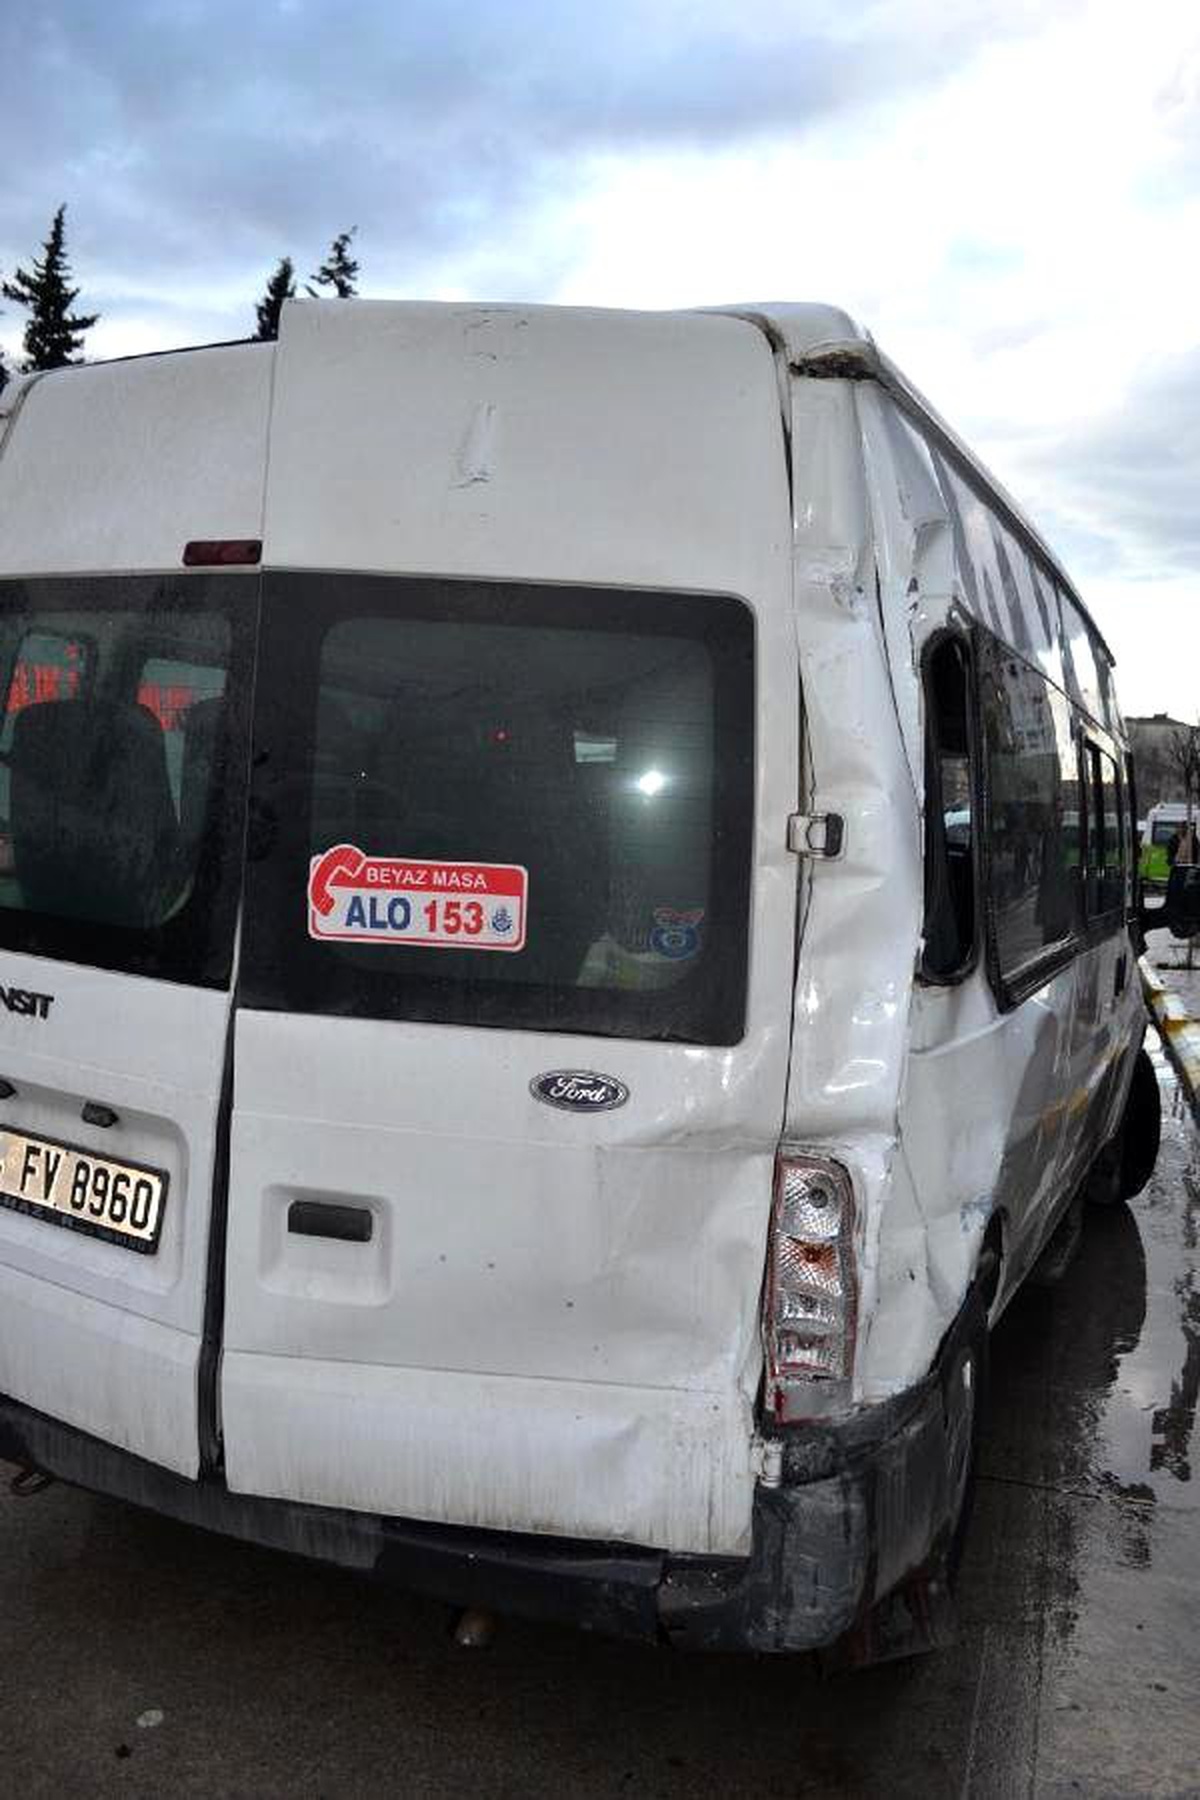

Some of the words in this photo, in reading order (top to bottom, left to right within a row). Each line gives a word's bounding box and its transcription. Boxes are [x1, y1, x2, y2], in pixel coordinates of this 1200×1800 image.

[366, 867, 427, 886] BEYAZ
[432, 872, 489, 889] MASA
[344, 896, 412, 930] ALO
[424, 900, 484, 935] 153
[549, 1077, 606, 1103] Ford
[20, 1145, 61, 1202] FV
[71, 1161, 154, 1231] 8960
